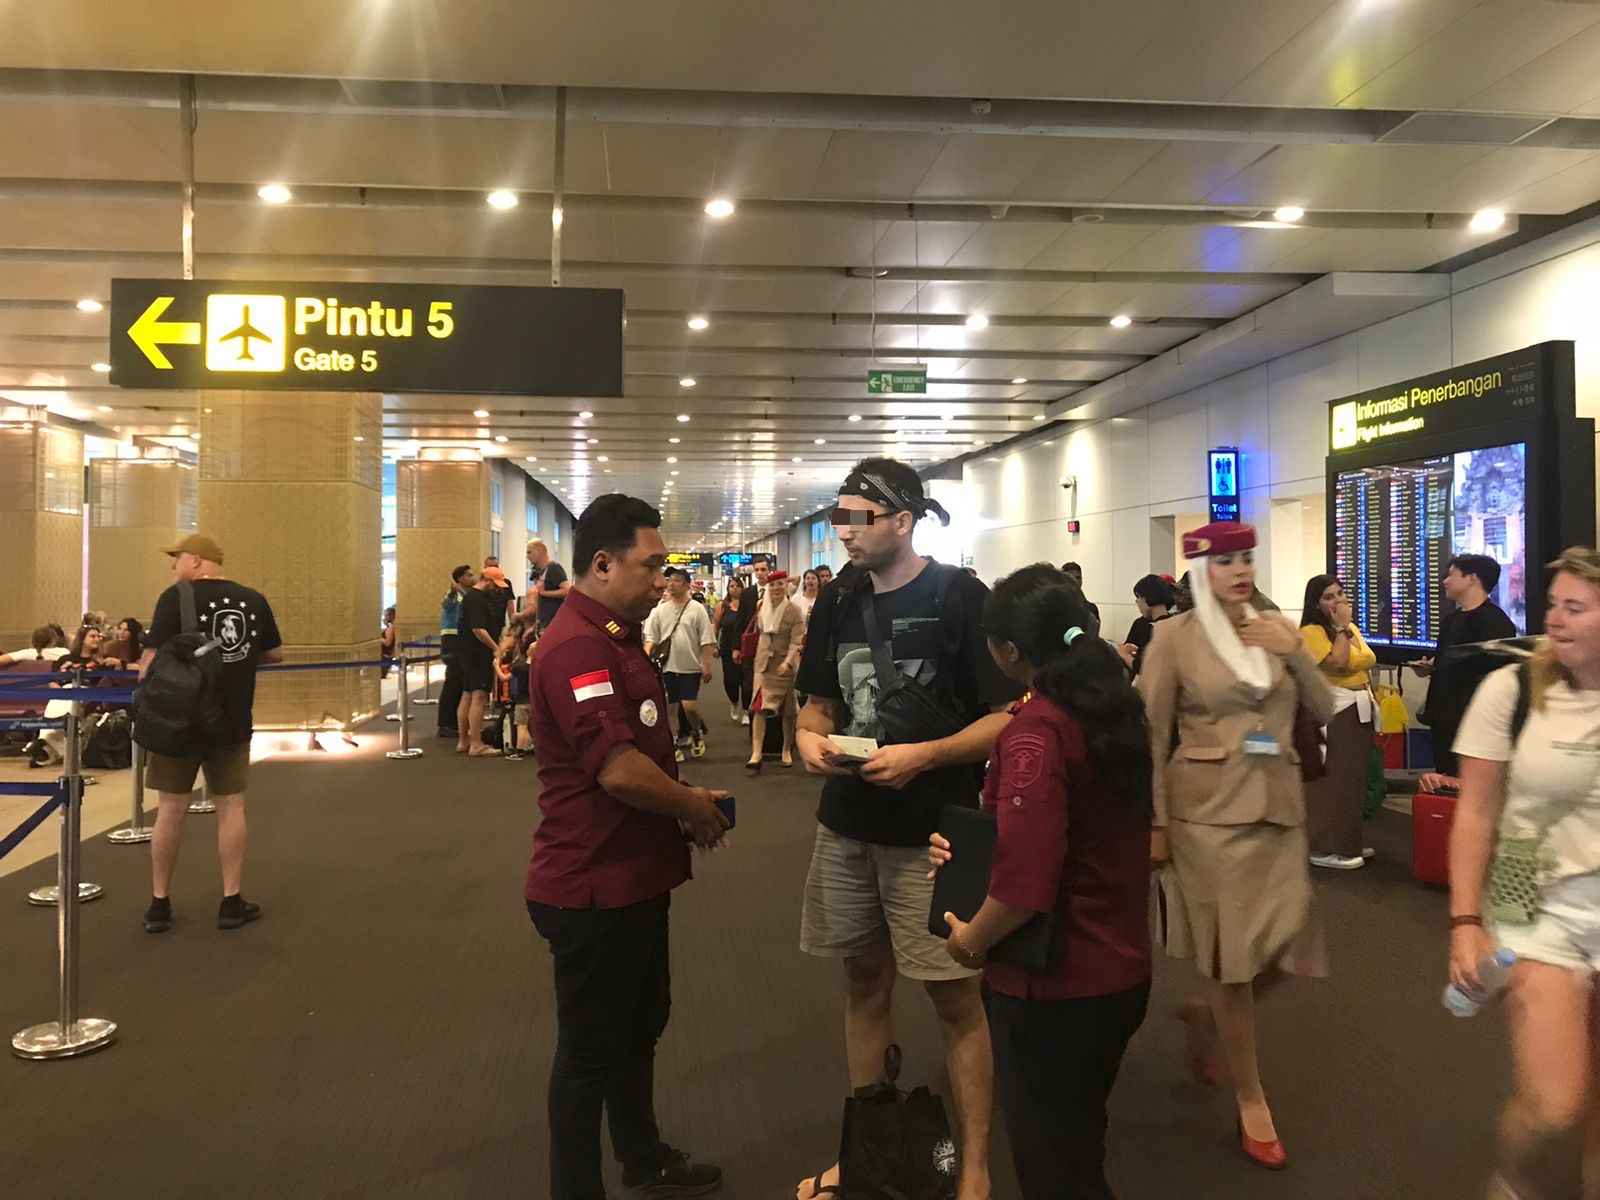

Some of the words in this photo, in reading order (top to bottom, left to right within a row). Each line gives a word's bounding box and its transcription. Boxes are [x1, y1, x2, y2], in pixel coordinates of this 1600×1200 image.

[294, 297, 413, 337] Pintu
[426, 301, 454, 339] 5
[293, 347, 356, 371] Gate
[360, 349, 378, 372] 5
[1357, 390, 1408, 420] Informasi
[1411, 371, 1502, 408] Penerbangan
[1379, 416, 1425, 437] Information
[1212, 503, 1238, 513] Toilet
